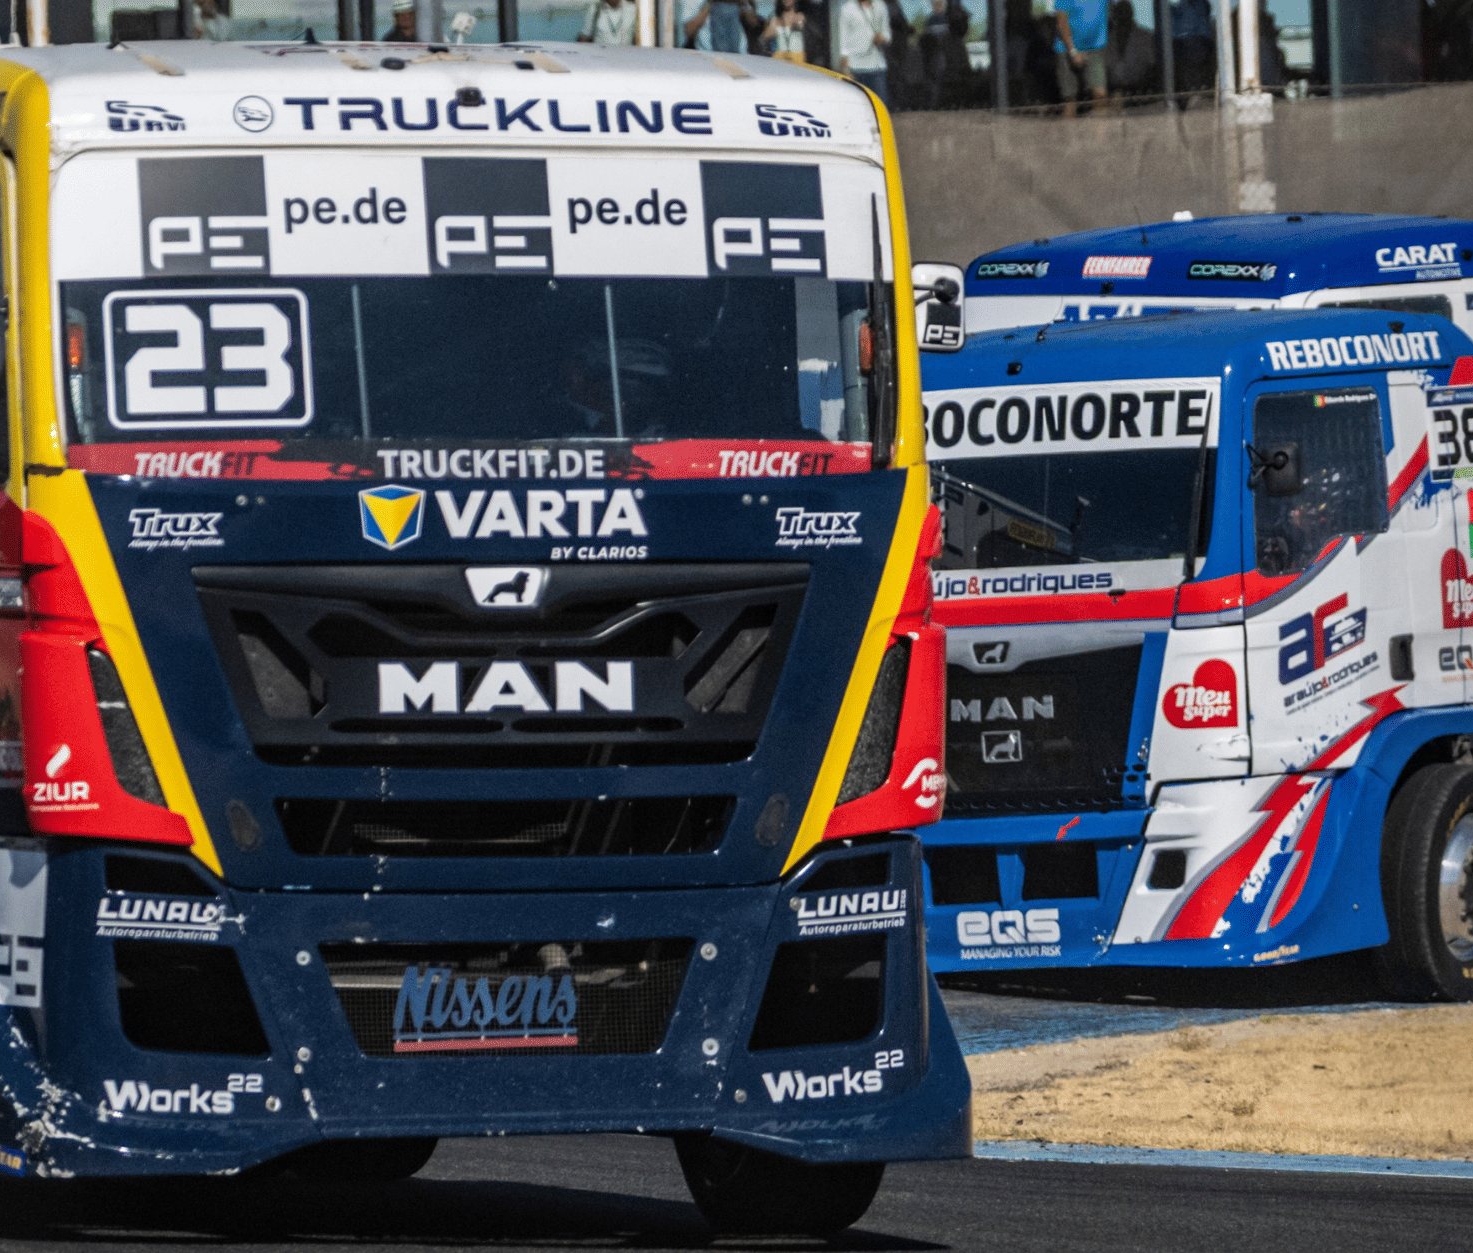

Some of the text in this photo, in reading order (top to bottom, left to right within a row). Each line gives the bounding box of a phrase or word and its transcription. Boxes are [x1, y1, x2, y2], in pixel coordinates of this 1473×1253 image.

[283, 97, 713, 134] TRUCKLINE
[284, 191, 408, 233] pe.de
[568, 190, 688, 234] pe.de
[1375, 243, 1459, 267] CARAT
[124, 302, 295, 416] 23
[1265, 331, 1442, 370] REBOCONORT
[135, 451, 261, 478] TRUCKFIT
[377, 449, 605, 479] TRUCKFIT.DE
[719, 449, 833, 477] TRUCKFIT
[128, 508, 224, 538] Trux
[435, 489, 647, 538] VARTA
[776, 507, 861, 535] Trux
[551, 546, 647, 559] BY CLARIOS
[379, 661, 634, 714] MAN
[1175, 682, 1231, 709] Meu
[951, 696, 1054, 722] MAN
[798, 890, 900, 918] LUNAU
[96, 925, 219, 941] Autoreparaturbetrieb
[799, 918, 905, 936] Autoreparaturbetrieb
[961, 945, 1061, 960] MANAGING YOUR RISK
[393, 966, 578, 1033] Nissens
[762, 1049, 905, 1102] Works 22
[103, 1073, 263, 1114] Works 22
